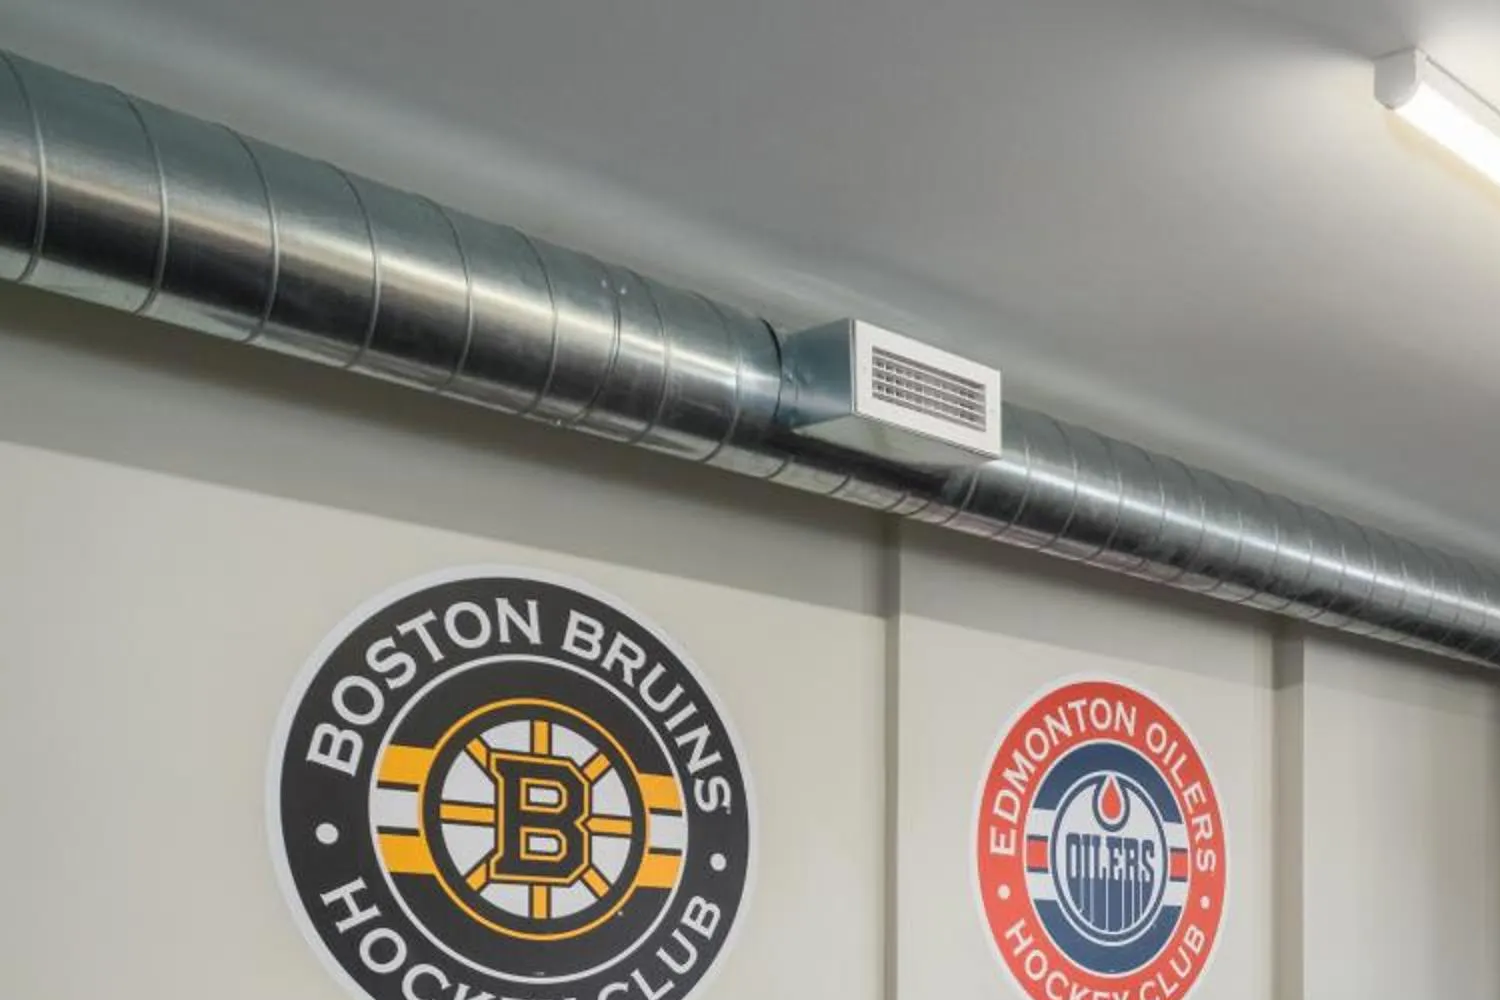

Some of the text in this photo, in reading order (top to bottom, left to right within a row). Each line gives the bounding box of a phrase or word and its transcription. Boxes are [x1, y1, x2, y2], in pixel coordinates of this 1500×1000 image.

[305, 597, 731, 814] BOSTON BRUINS
[489, 750, 593, 886] B
[989, 697, 1217, 873] EDMONTON OILERS
[1065, 832, 1155, 884] OILERS
